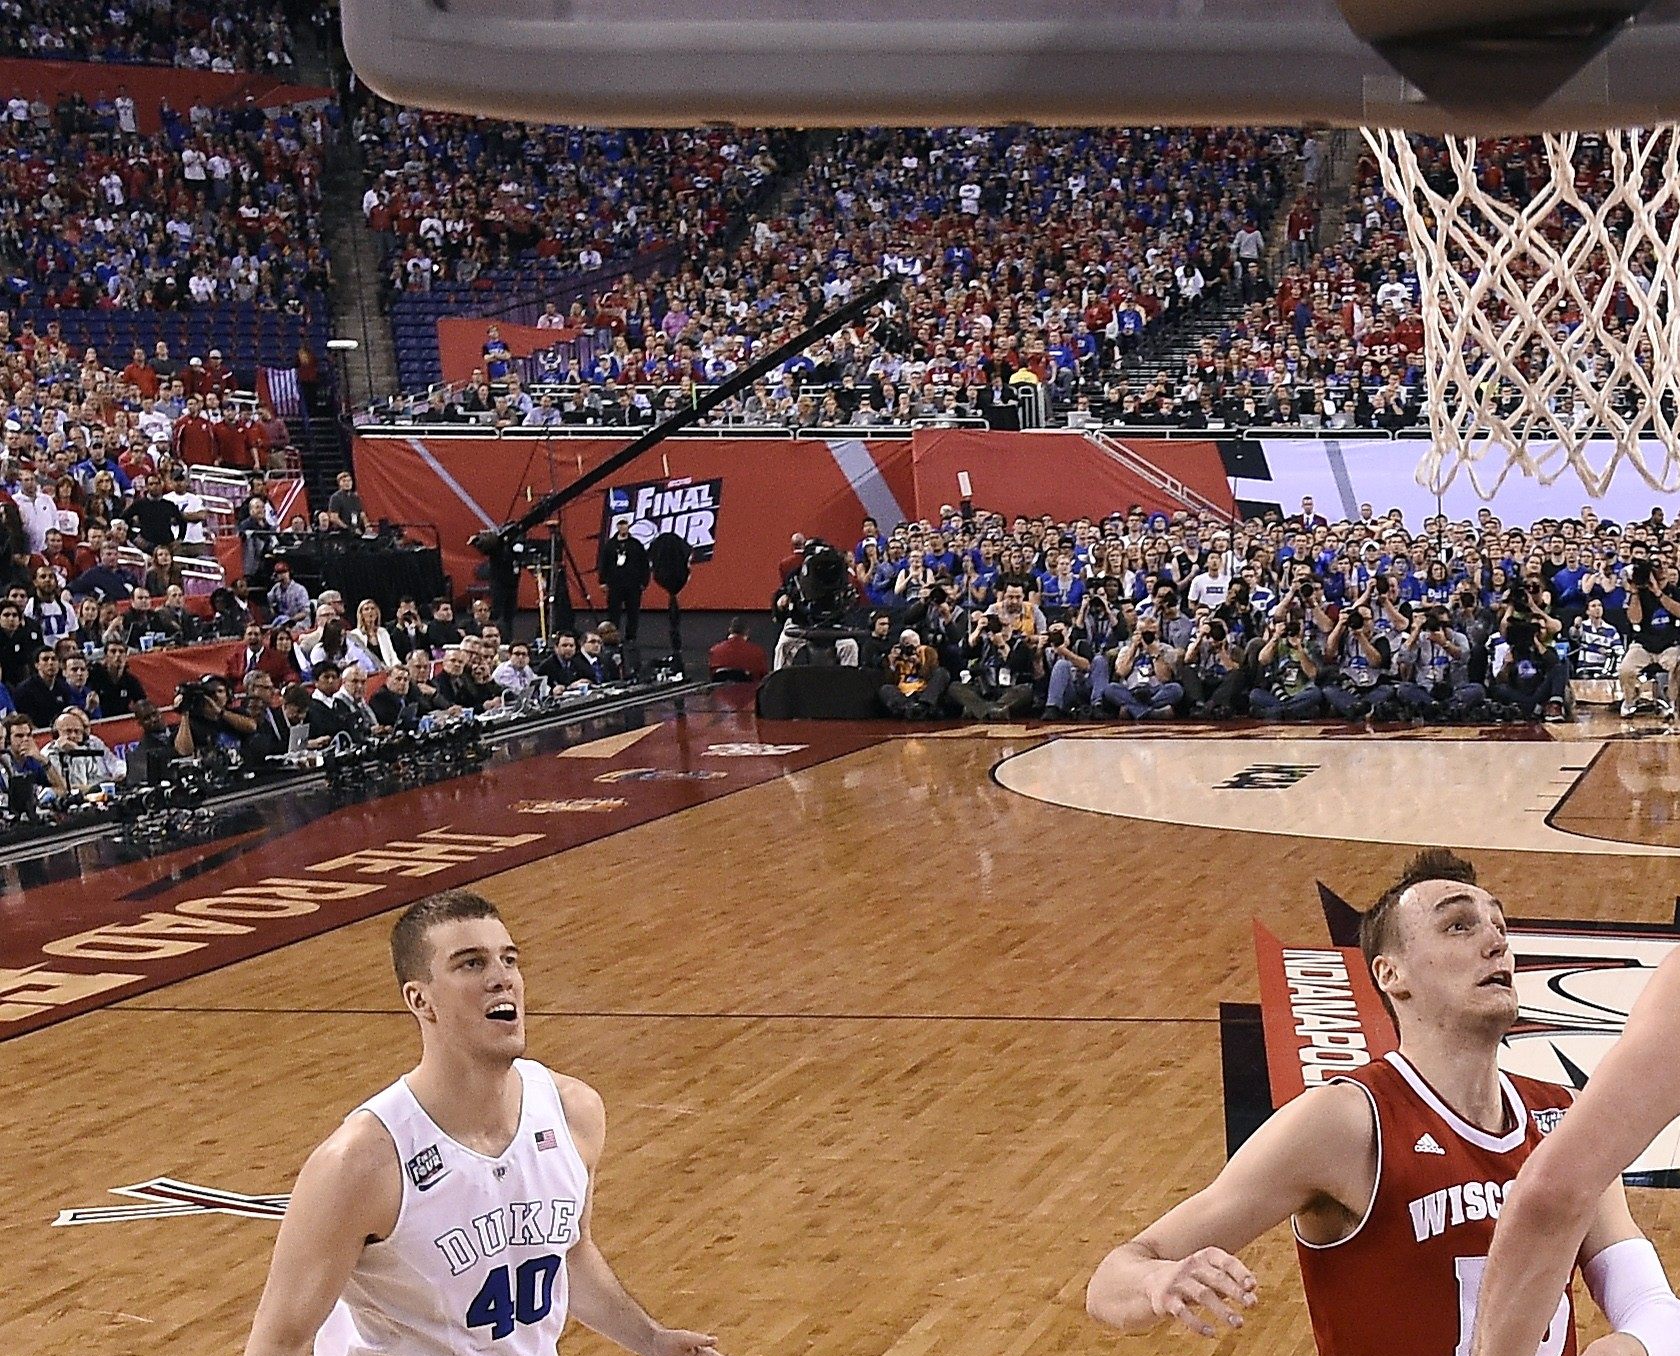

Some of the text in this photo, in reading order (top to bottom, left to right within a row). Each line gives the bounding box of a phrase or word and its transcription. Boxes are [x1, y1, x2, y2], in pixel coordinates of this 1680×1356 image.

[635, 484, 713, 520] FINAL
[305, 825, 547, 878] THE
[42, 878, 387, 961] ROAD
[434, 1200, 576, 1276] DUKE
[466, 1254, 561, 1341] 40
